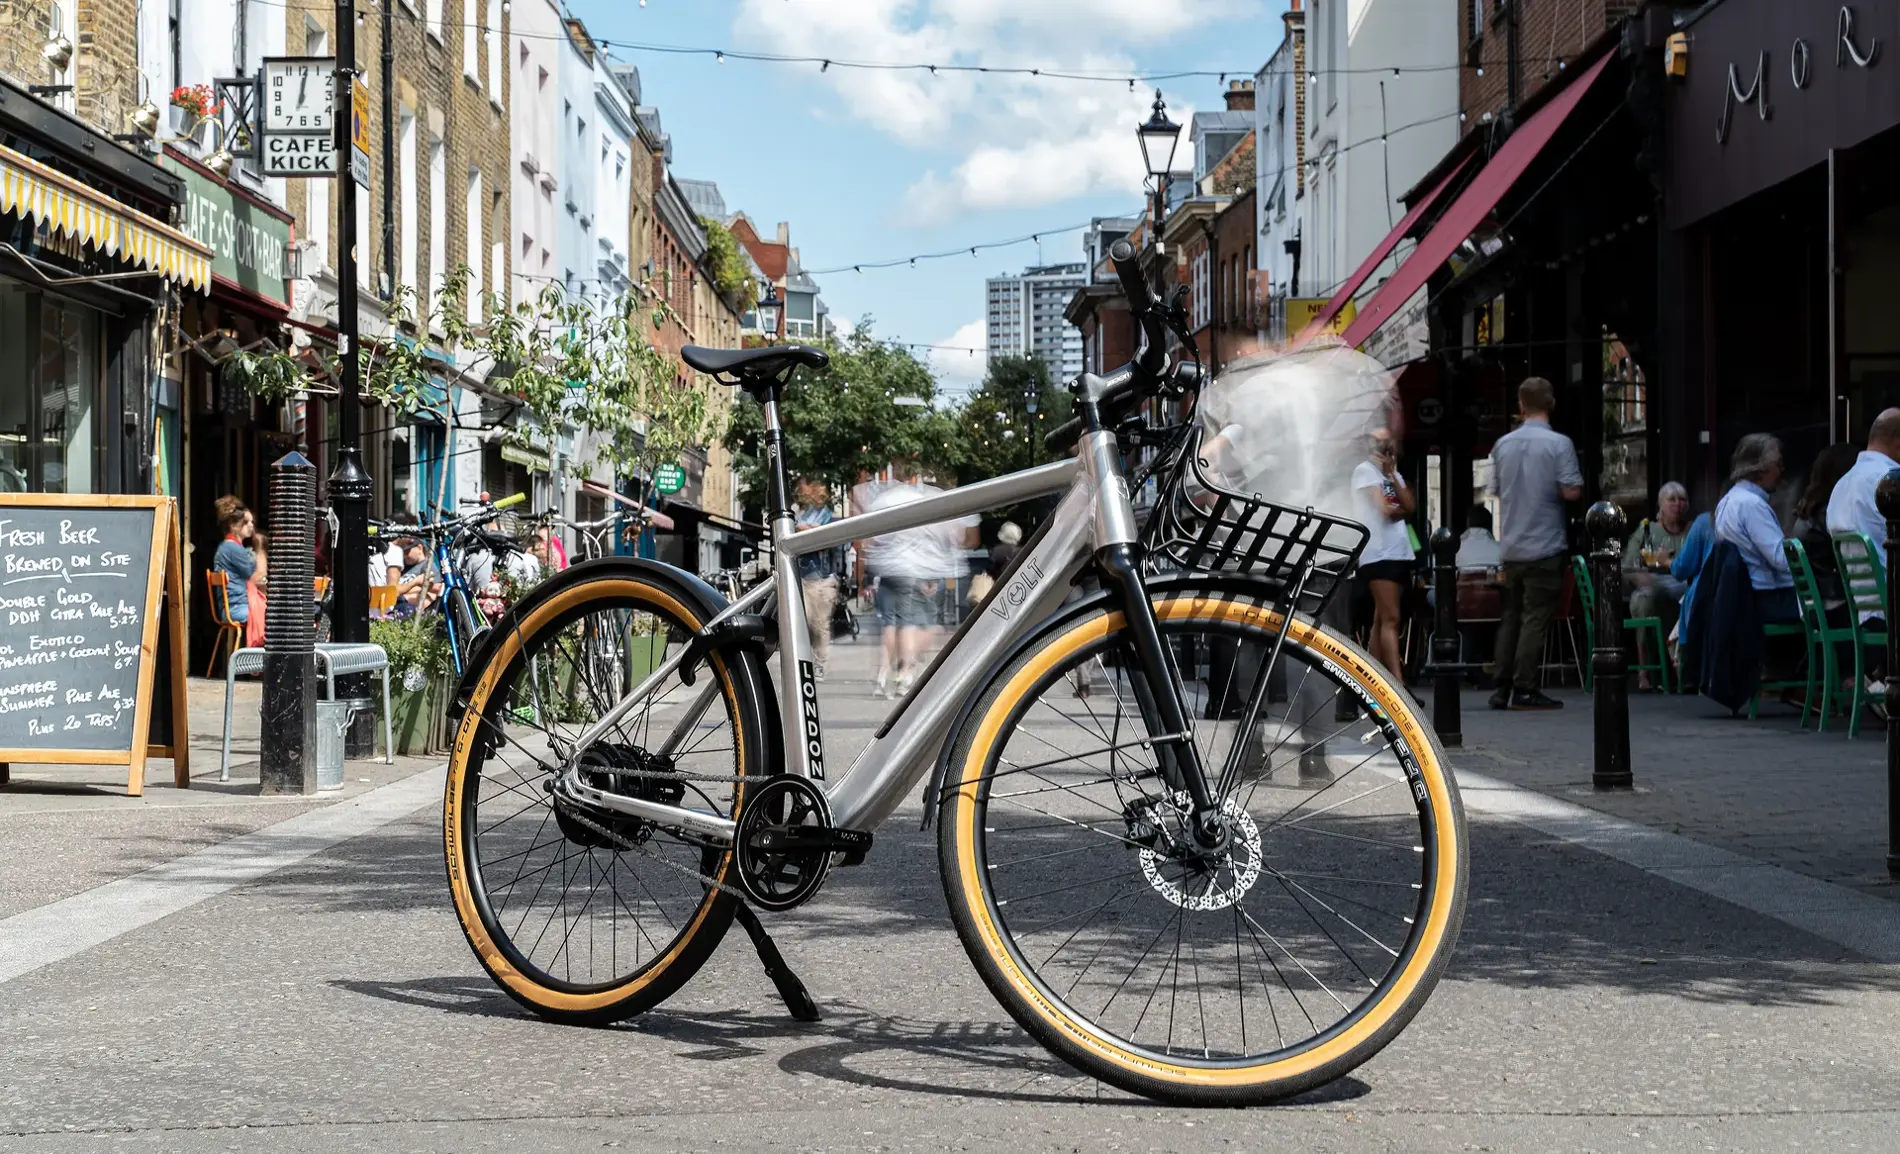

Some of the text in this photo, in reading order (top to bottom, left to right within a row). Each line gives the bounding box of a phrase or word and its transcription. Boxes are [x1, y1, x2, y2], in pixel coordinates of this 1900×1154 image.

[273, 76, 283, 87] 10
[275, 91, 282, 101] 9
[275, 106, 282, 116] 8
[269, 138, 331, 153] CAFE
[271, 156, 330, 170] KICK
[262, 231, 282, 283] BAR
[0, 519, 45, 547] FRESH
[4, 551, 131, 574] BREWED ON SITE
[57, 587, 93, 606] GOLD
[991, 556, 1044, 621] VOLT
[9, 609, 41, 626] DDH
[1322, 659, 1374, 704] ALEXRIMS
[0, 694, 55, 714] SUMMER
[63, 714, 82, 731] 20
[802, 662, 823, 777] LONDON
[447, 779, 460, 881] SCHWALBE
